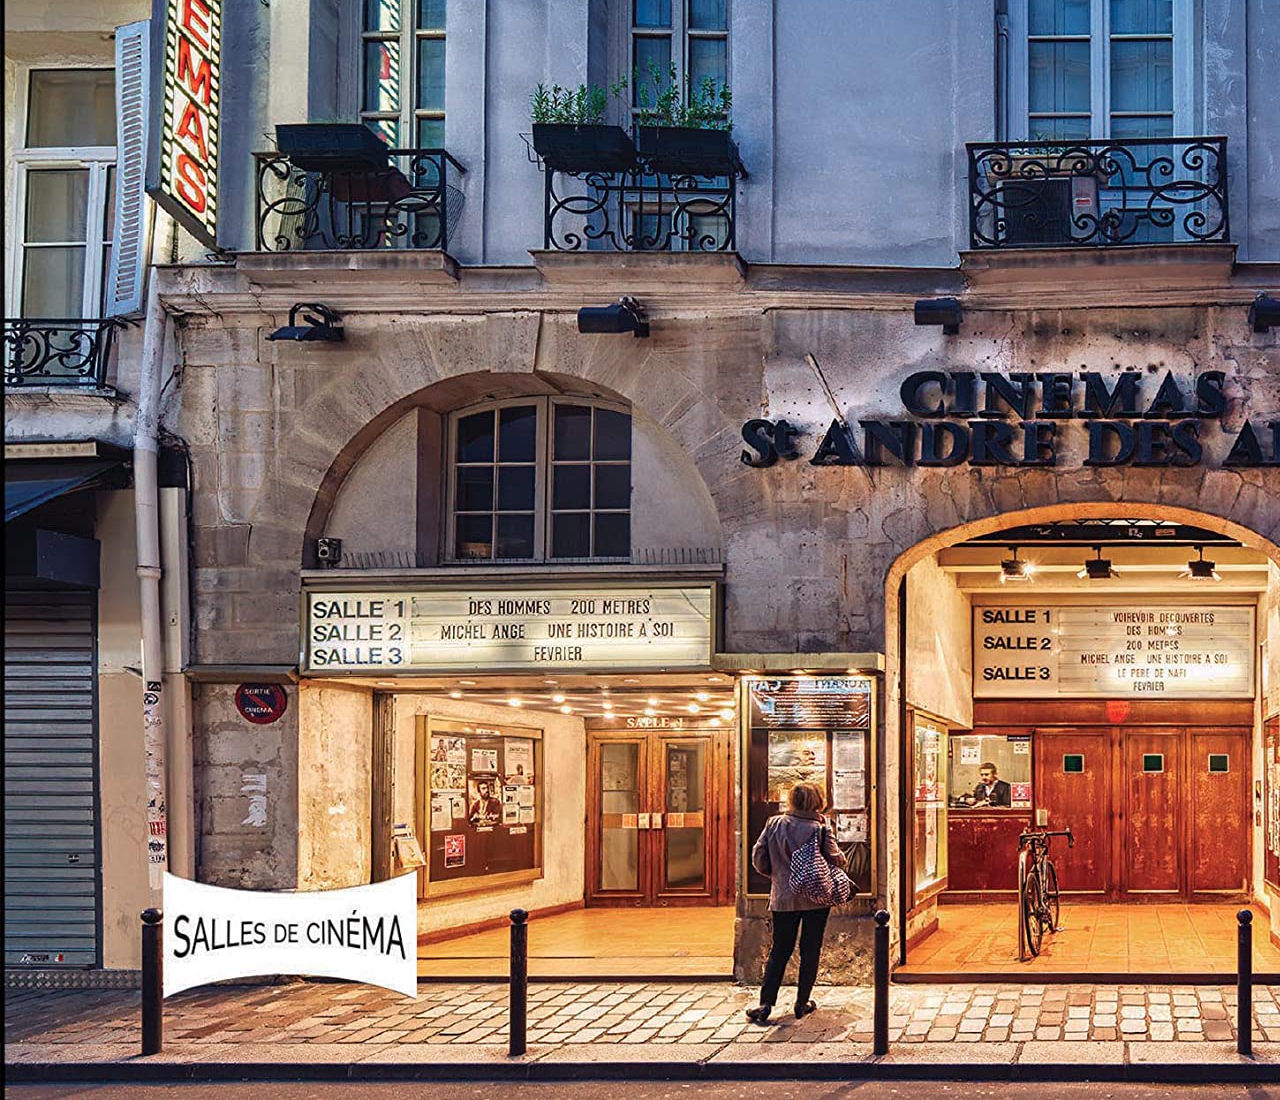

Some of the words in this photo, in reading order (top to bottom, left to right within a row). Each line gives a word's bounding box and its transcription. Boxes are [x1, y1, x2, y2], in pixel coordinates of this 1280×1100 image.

[899, 371, 1229, 419] CINEMAS
[740, 418, 799, 468] St
[809, 418, 1057, 468] ANDRE
[1083, 419, 1203, 468] DES
[313, 602, 383, 619] SALLE
[393, 602, 405, 618] 1
[468, 600, 492, 615] DES
[498, 600, 551, 616] HOMMES
[571, 599, 595, 614] 200
[602, 599, 651, 615] METRES
[982, 610, 1036, 624] SALLE
[1042, 611, 1051, 623] 1
[1159, 612, 1215, 624] DECOUVERTES
[313, 624, 383, 642] SALLE
[388, 624, 403, 642] 2
[440, 624, 487, 639] MICHEL
[493, 624, 525, 639] ANGE
[547, 623, 573, 639] UNE
[577, 623, 636, 638] HISTOIRE
[638, 623, 647, 637] A
[652, 622, 674, 637] SOI
[1126, 625, 1142, 636] DES
[1148, 625, 1183, 636] HOMS
[983, 637, 1037, 649] SALLE
[1040, 638, 1051, 650] 2
[1126, 640, 1142, 650] 200
[313, 647, 383, 665] SALLE
[388, 647, 403, 665] 3
[534, 646, 582, 661] FEVRIER
[1080, 653, 1110, 665] MICHEL
[1114, 653, 1136, 664] ANGE
[1146, 653, 1162, 664] UNE
[1165, 653, 1202, 664] HISTOIRE
[1204, 654, 1212, 664] A
[1214, 653, 1229, 664] SOI
[982, 667, 1036, 680] SALLE
[1040, 667, 1051, 680] 3
[1117, 668, 1127, 678] LE
[1130, 668, 1150, 678] PERE
[1154, 668, 1164, 678] DE
[1168, 668, 1187, 678] NAFI
[1133, 681, 1165, 692] FEVRIER
